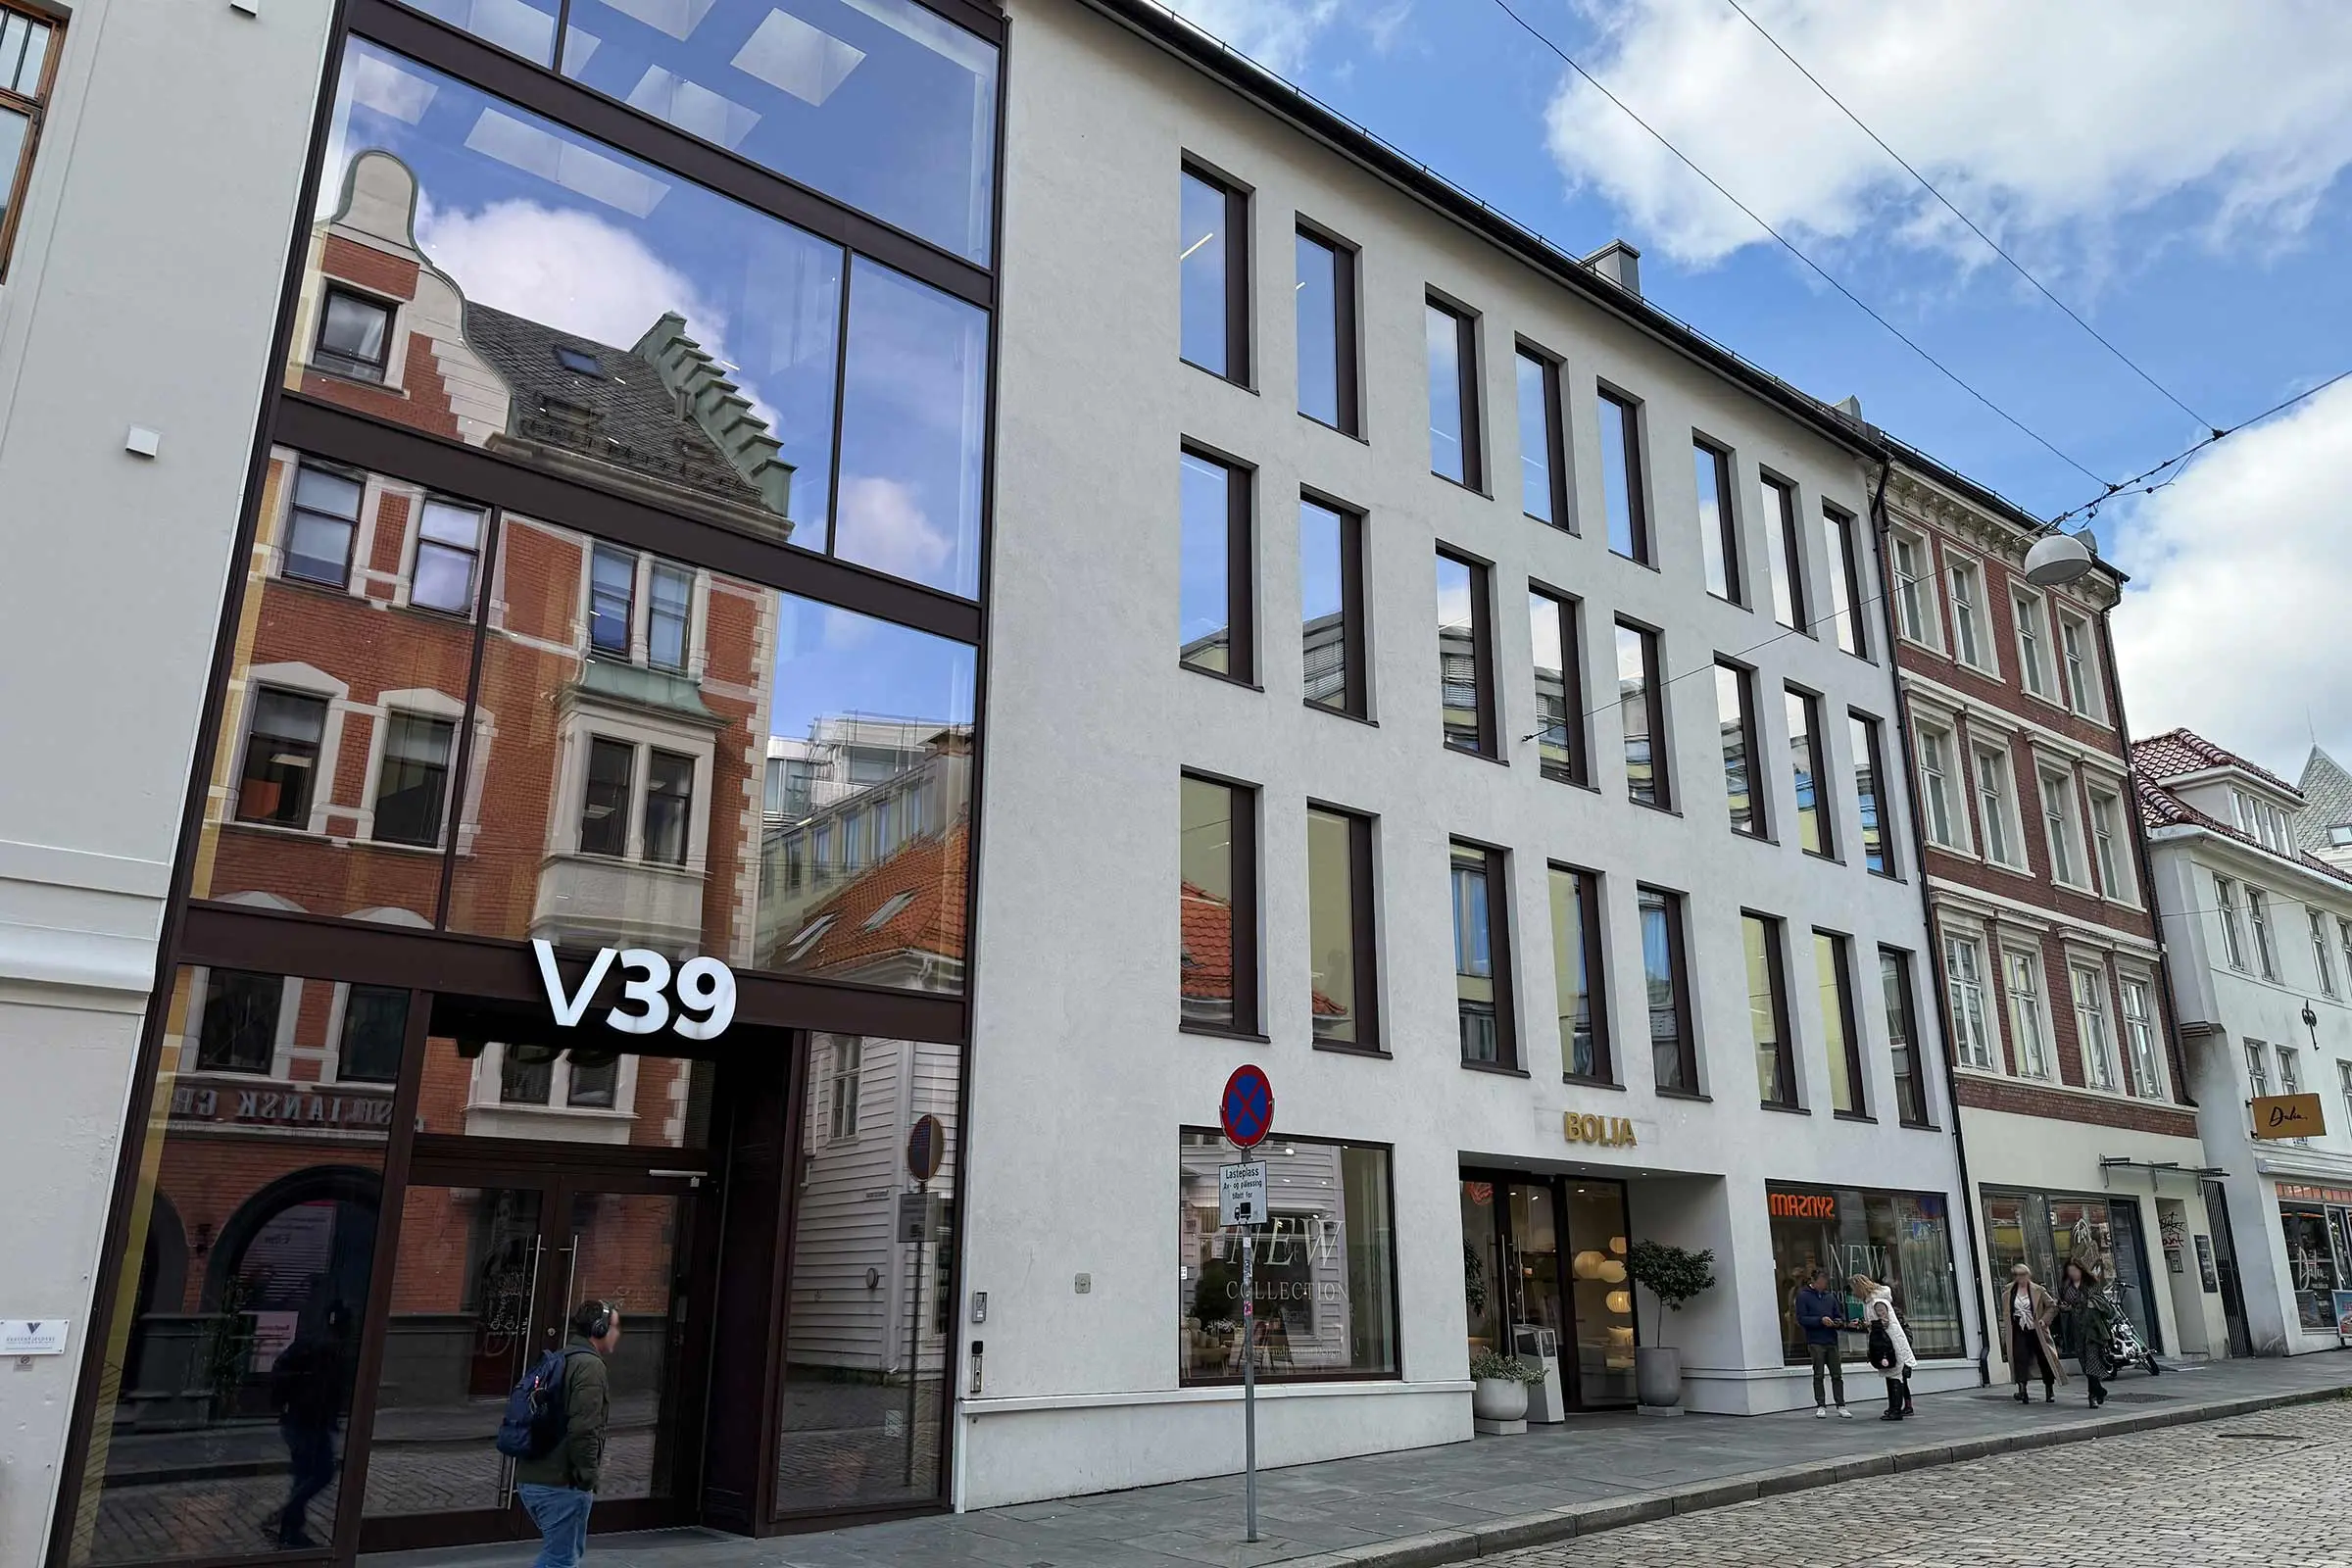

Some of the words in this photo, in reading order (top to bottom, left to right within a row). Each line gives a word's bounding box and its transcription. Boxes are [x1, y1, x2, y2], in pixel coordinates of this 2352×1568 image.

[532, 938, 737, 1041] V39
[1564, 1111, 1638, 1148] BOLIA
[1225, 1167, 1259, 1180] Lasteplass
[1226, 1216, 1345, 1267] NEW
[1828, 1244, 1886, 1280] NEW
